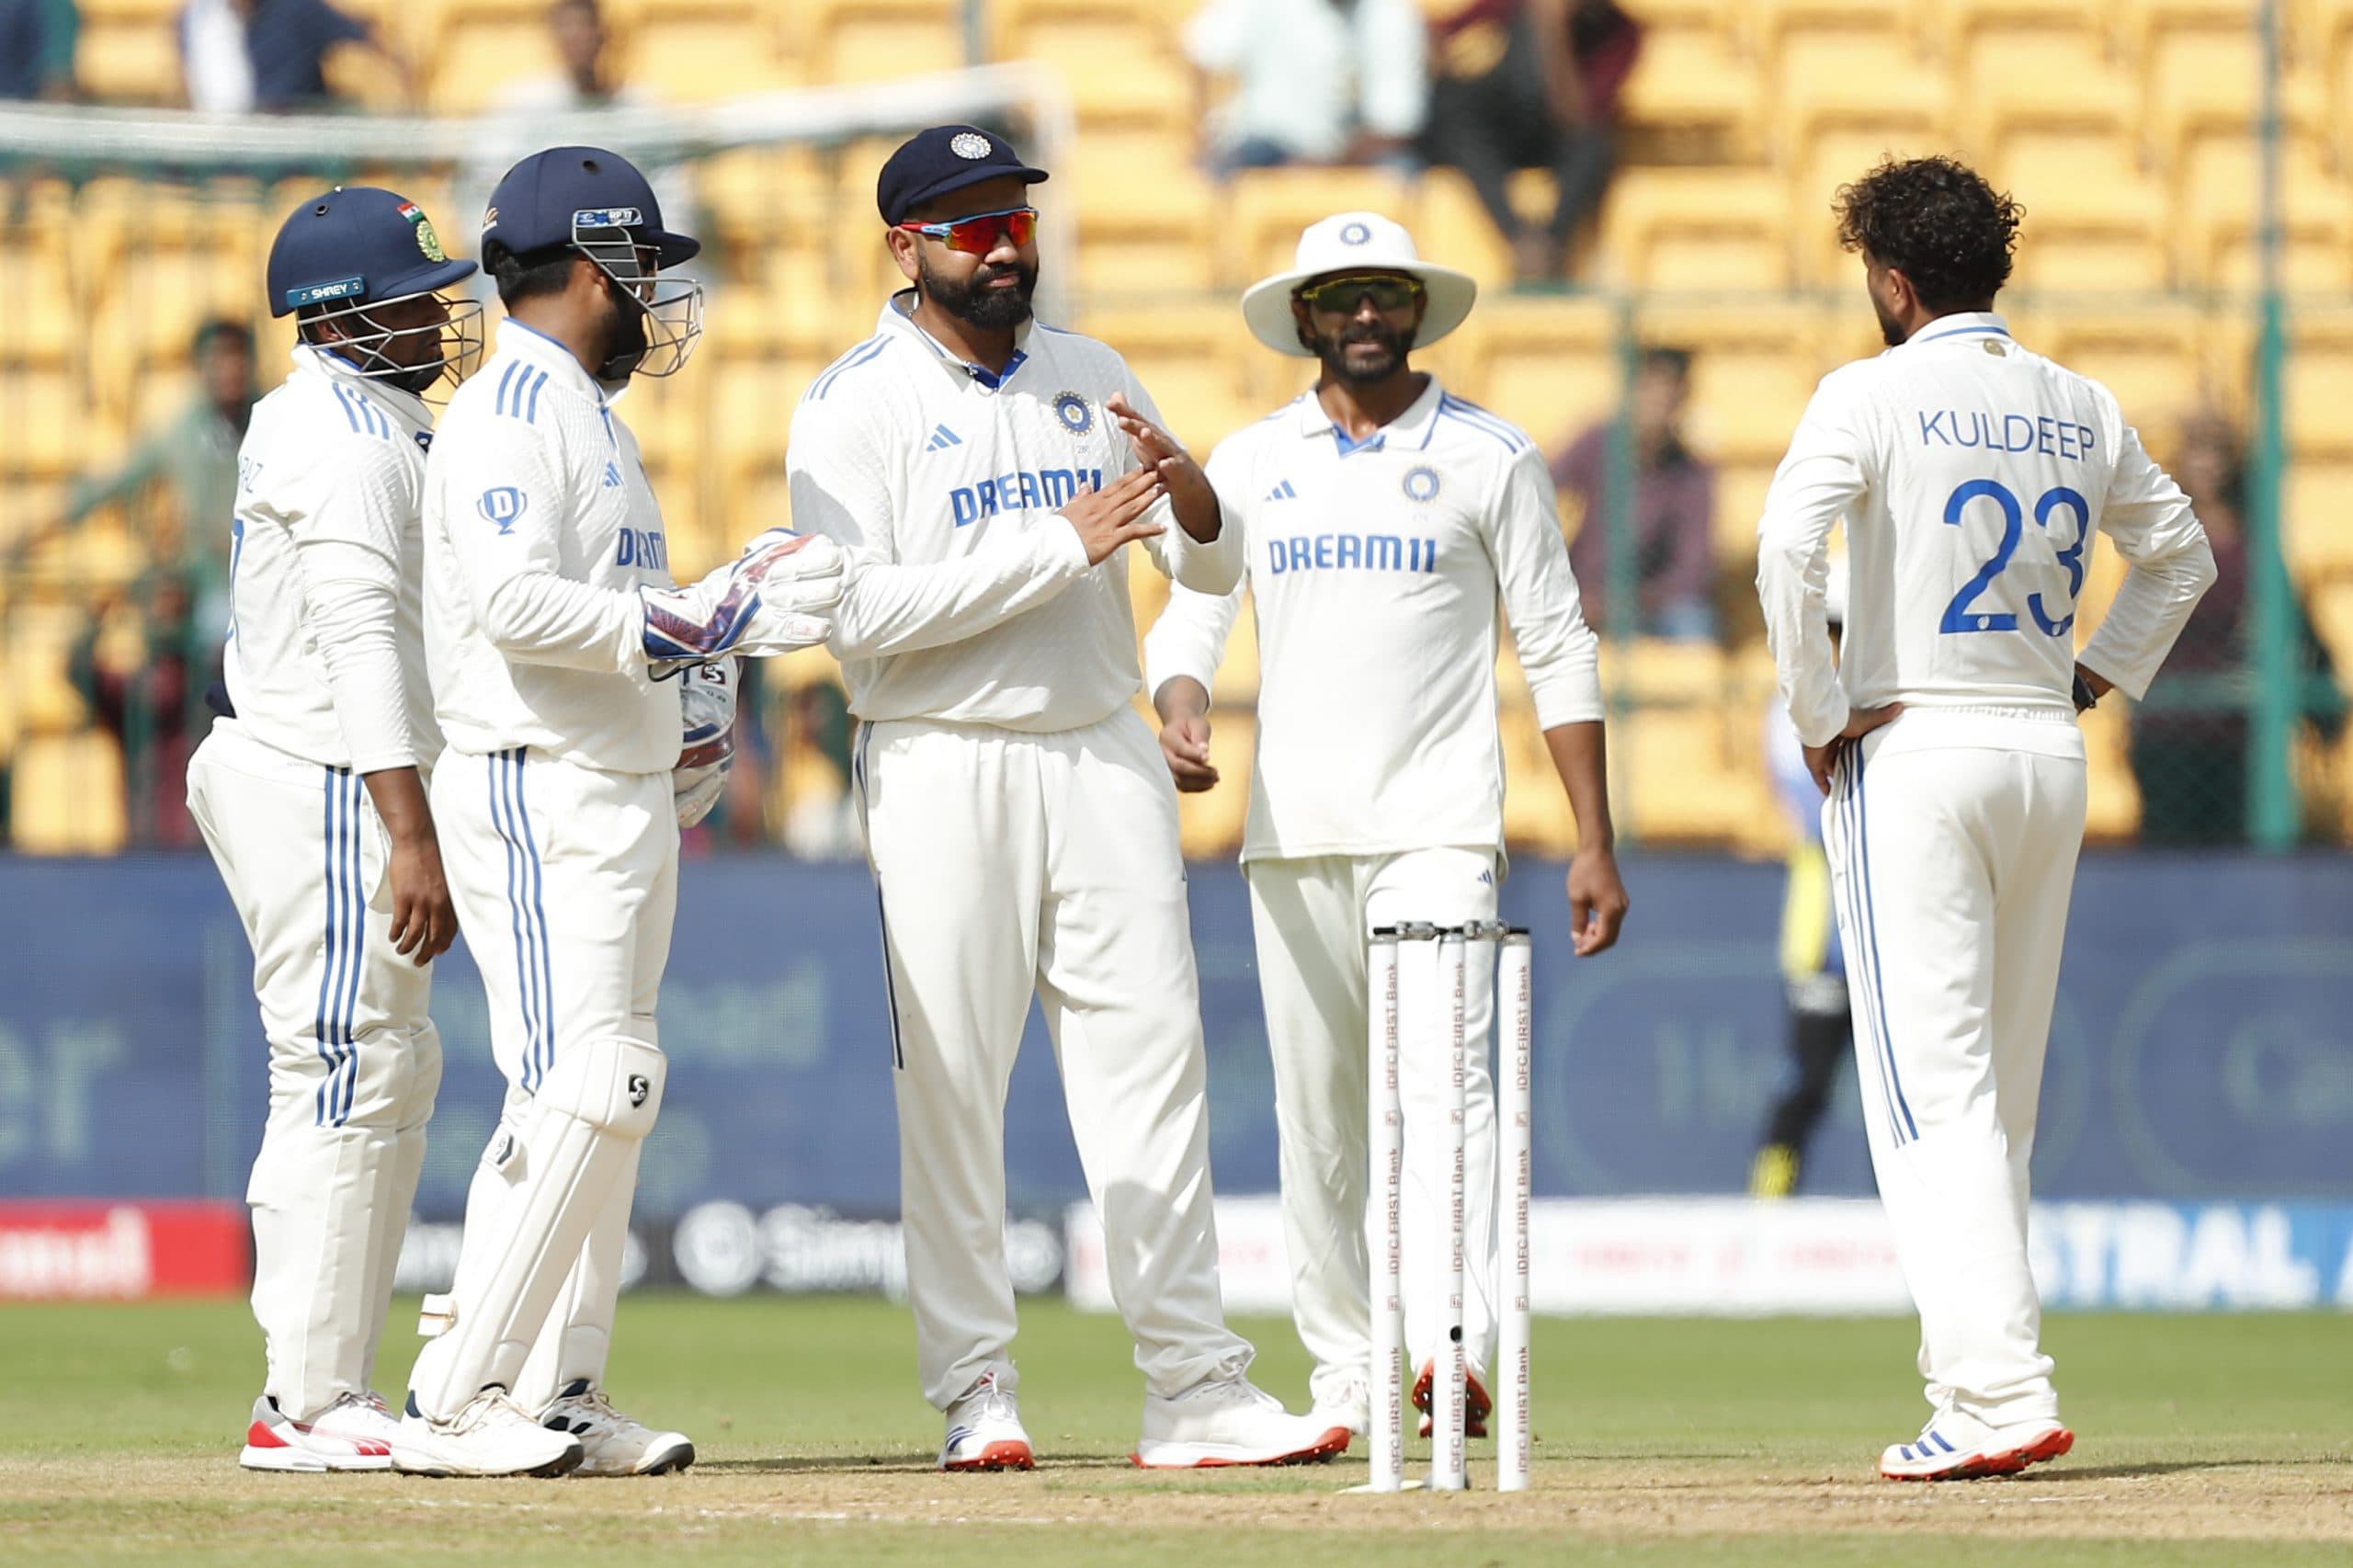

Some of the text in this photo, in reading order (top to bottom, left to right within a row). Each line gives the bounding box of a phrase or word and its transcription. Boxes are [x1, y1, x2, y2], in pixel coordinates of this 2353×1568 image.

[311, 283, 348, 300] SHREY
[1919, 411, 2095, 461] KULDEEP
[1268, 535, 1436, 574] DREAM11
[1938, 479, 2089, 638] 23
[1385, 964, 1398, 1089] IDFC FIRST Bank
[1451, 963, 1465, 1088] IDFC FIRST Bank
[1517, 965, 1529, 1091] IDFC FIRST Bank
[1388, 1148, 1400, 1275] IDFC FIRST Bank
[1451, 1147, 1464, 1272] IDFC FIRST Bank
[1517, 1149, 1529, 1275] IDFC FIRST Bank
[1389, 1347, 1402, 1474] IDFC FIRST Bank
[1450, 1344, 1465, 1472] IDFC FIRST Bank
[1517, 1346, 1529, 1472] IDFC FIRST Bank
